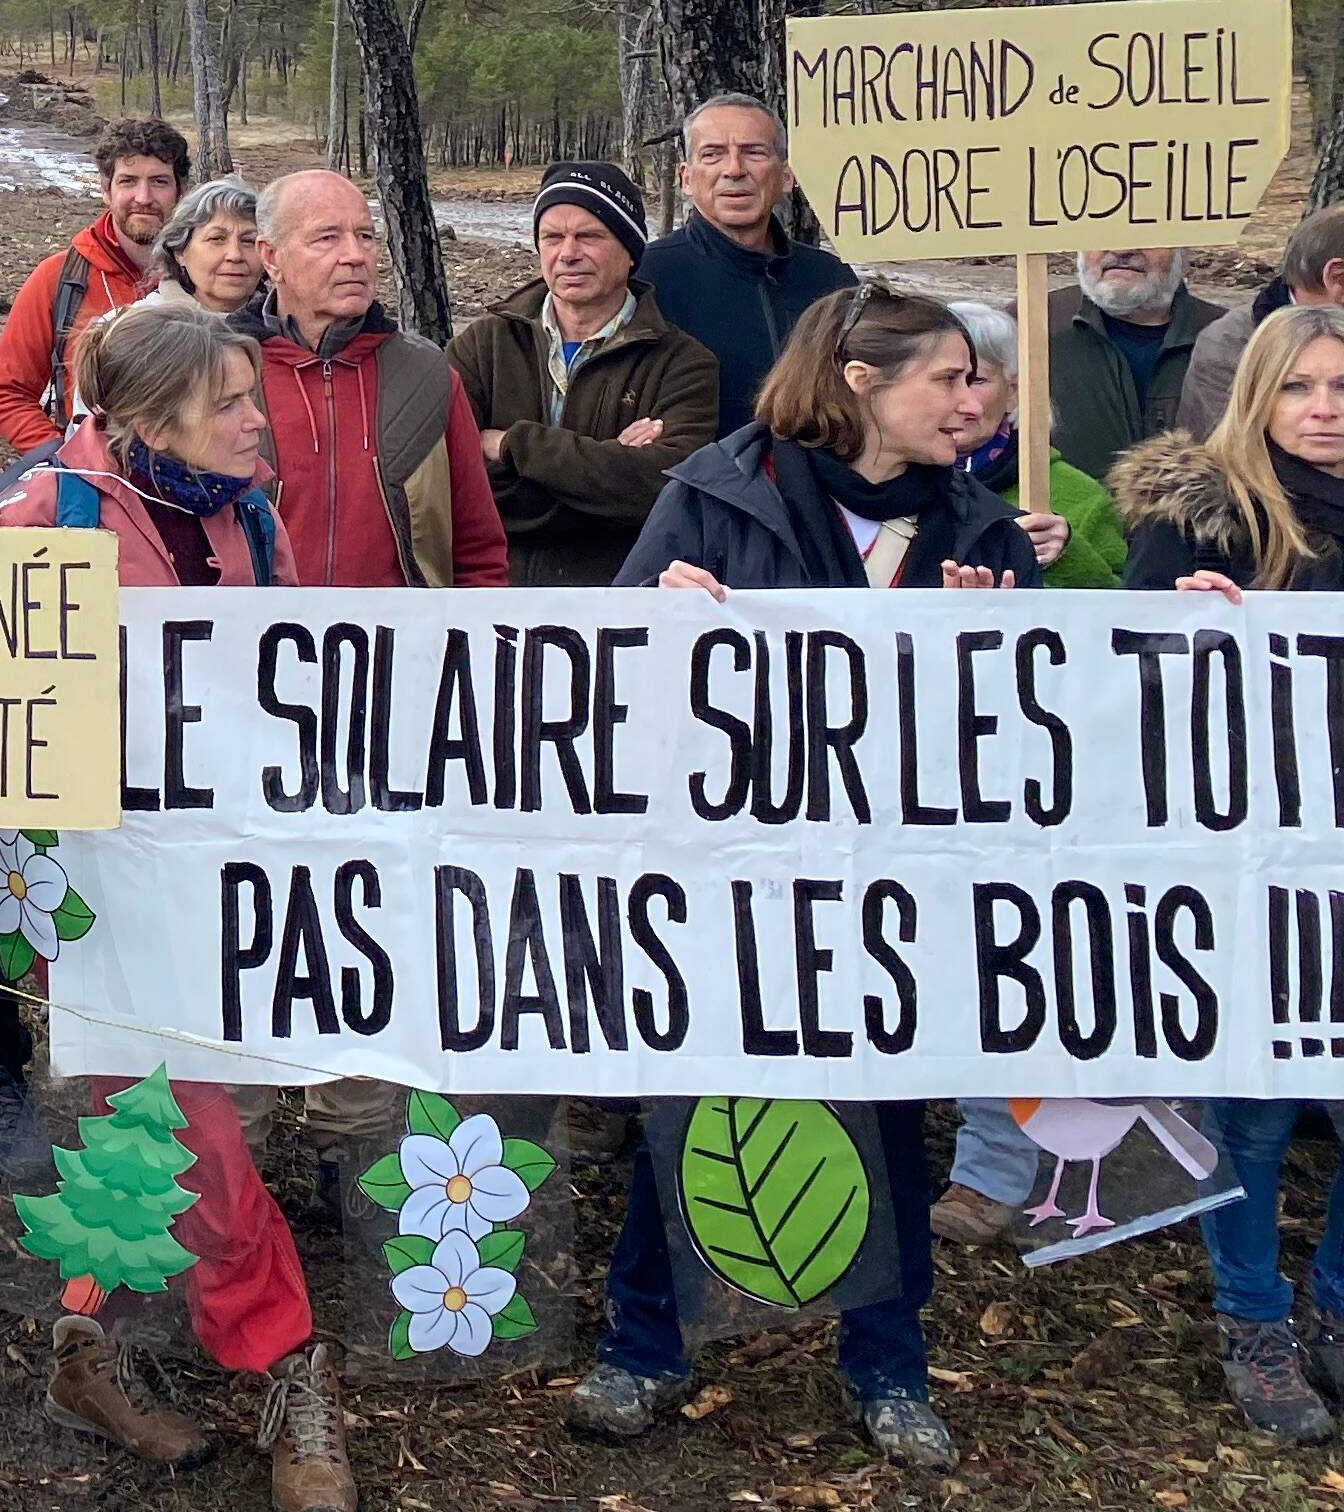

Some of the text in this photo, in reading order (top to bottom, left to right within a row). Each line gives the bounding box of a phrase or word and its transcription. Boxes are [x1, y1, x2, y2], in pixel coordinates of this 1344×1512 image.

[793, 38, 1034, 129] MARCHAND
[1048, 74, 1080, 105] de
[834, 146, 1003, 237] ADORE
[119, 620, 215, 812] LE
[688, 627, 872, 826] SUR
[895, 627, 1073, 829] LES
[220, 858, 395, 1043] PAS
[433, 864, 690, 1055] DANS
[730, 878, 918, 1058] LES
